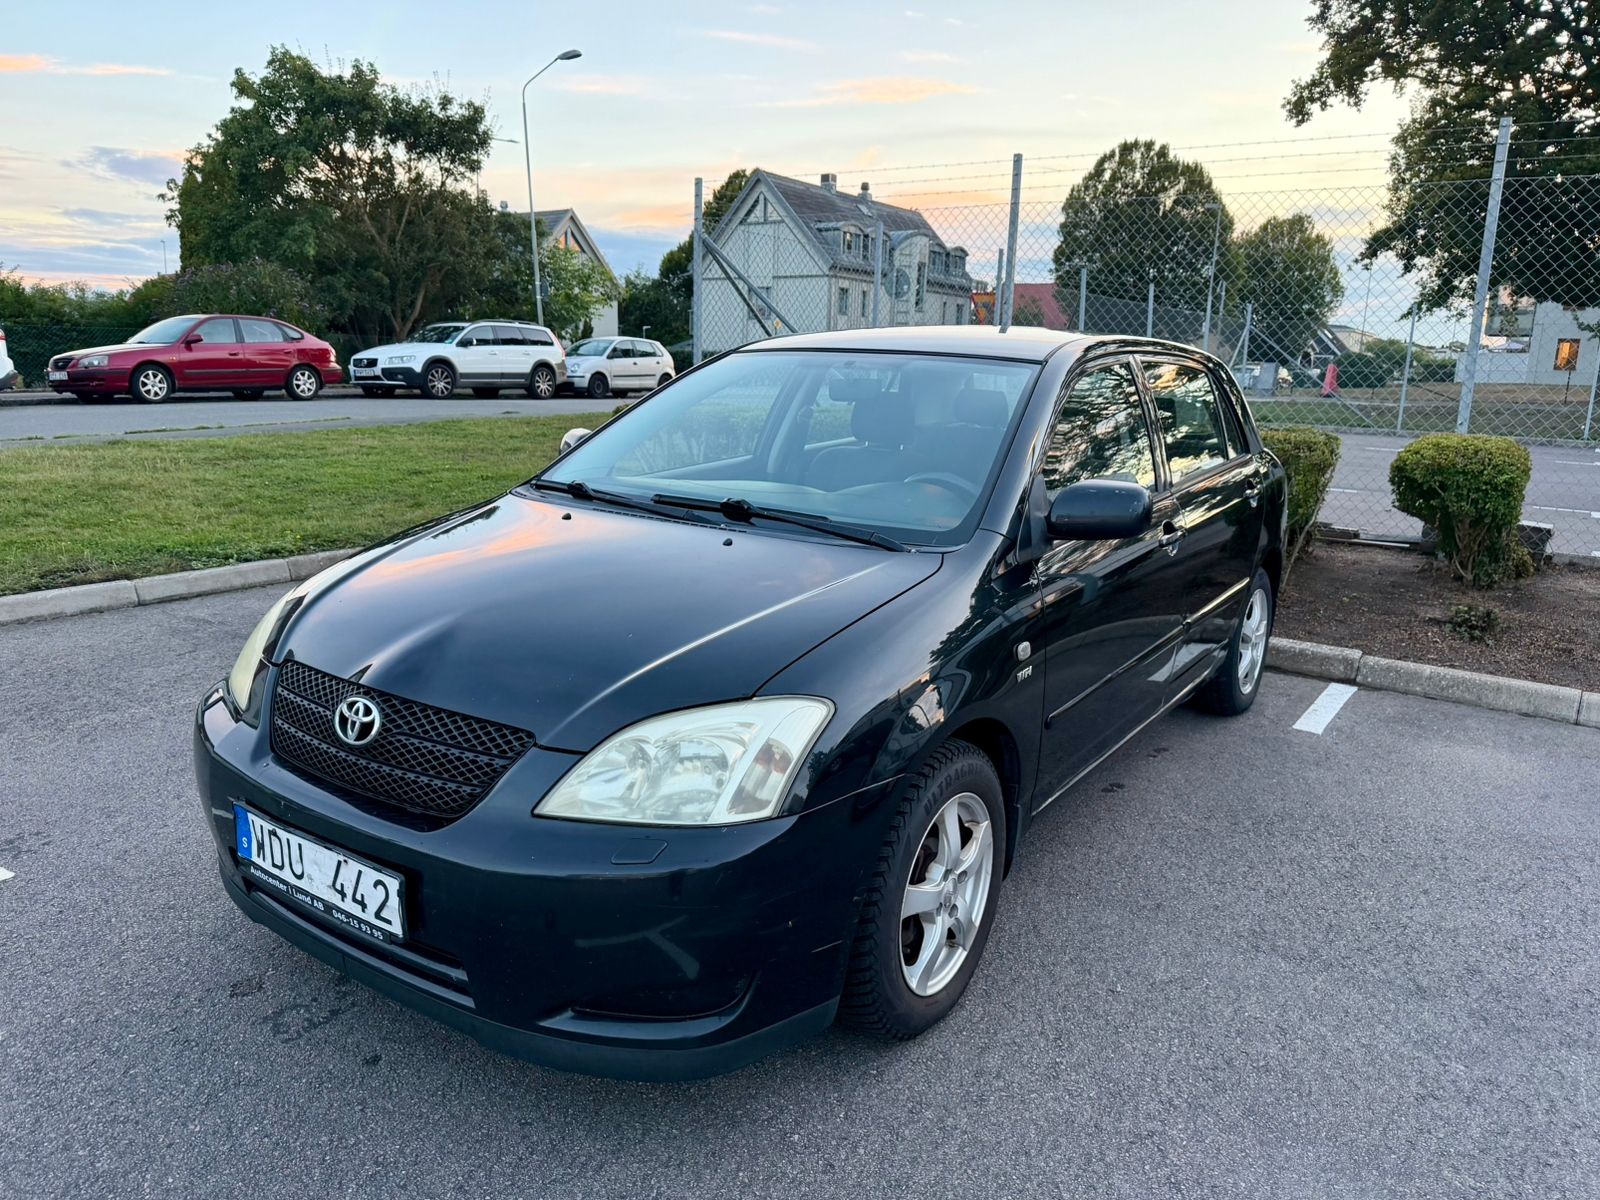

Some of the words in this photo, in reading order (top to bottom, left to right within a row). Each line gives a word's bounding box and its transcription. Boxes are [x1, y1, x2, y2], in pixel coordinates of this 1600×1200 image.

[242, 837, 248, 848] S
[250, 865, 288, 892] Autocenter
[292, 888, 312, 905] Lund
[313, 899, 325, 911] AB
[251, 818, 305, 880] WDU
[331, 859, 393, 926] 442
[332, 909, 359, 928] 046-15
[360, 923, 371, 934] 93
[372, 929, 383, 940] 95
